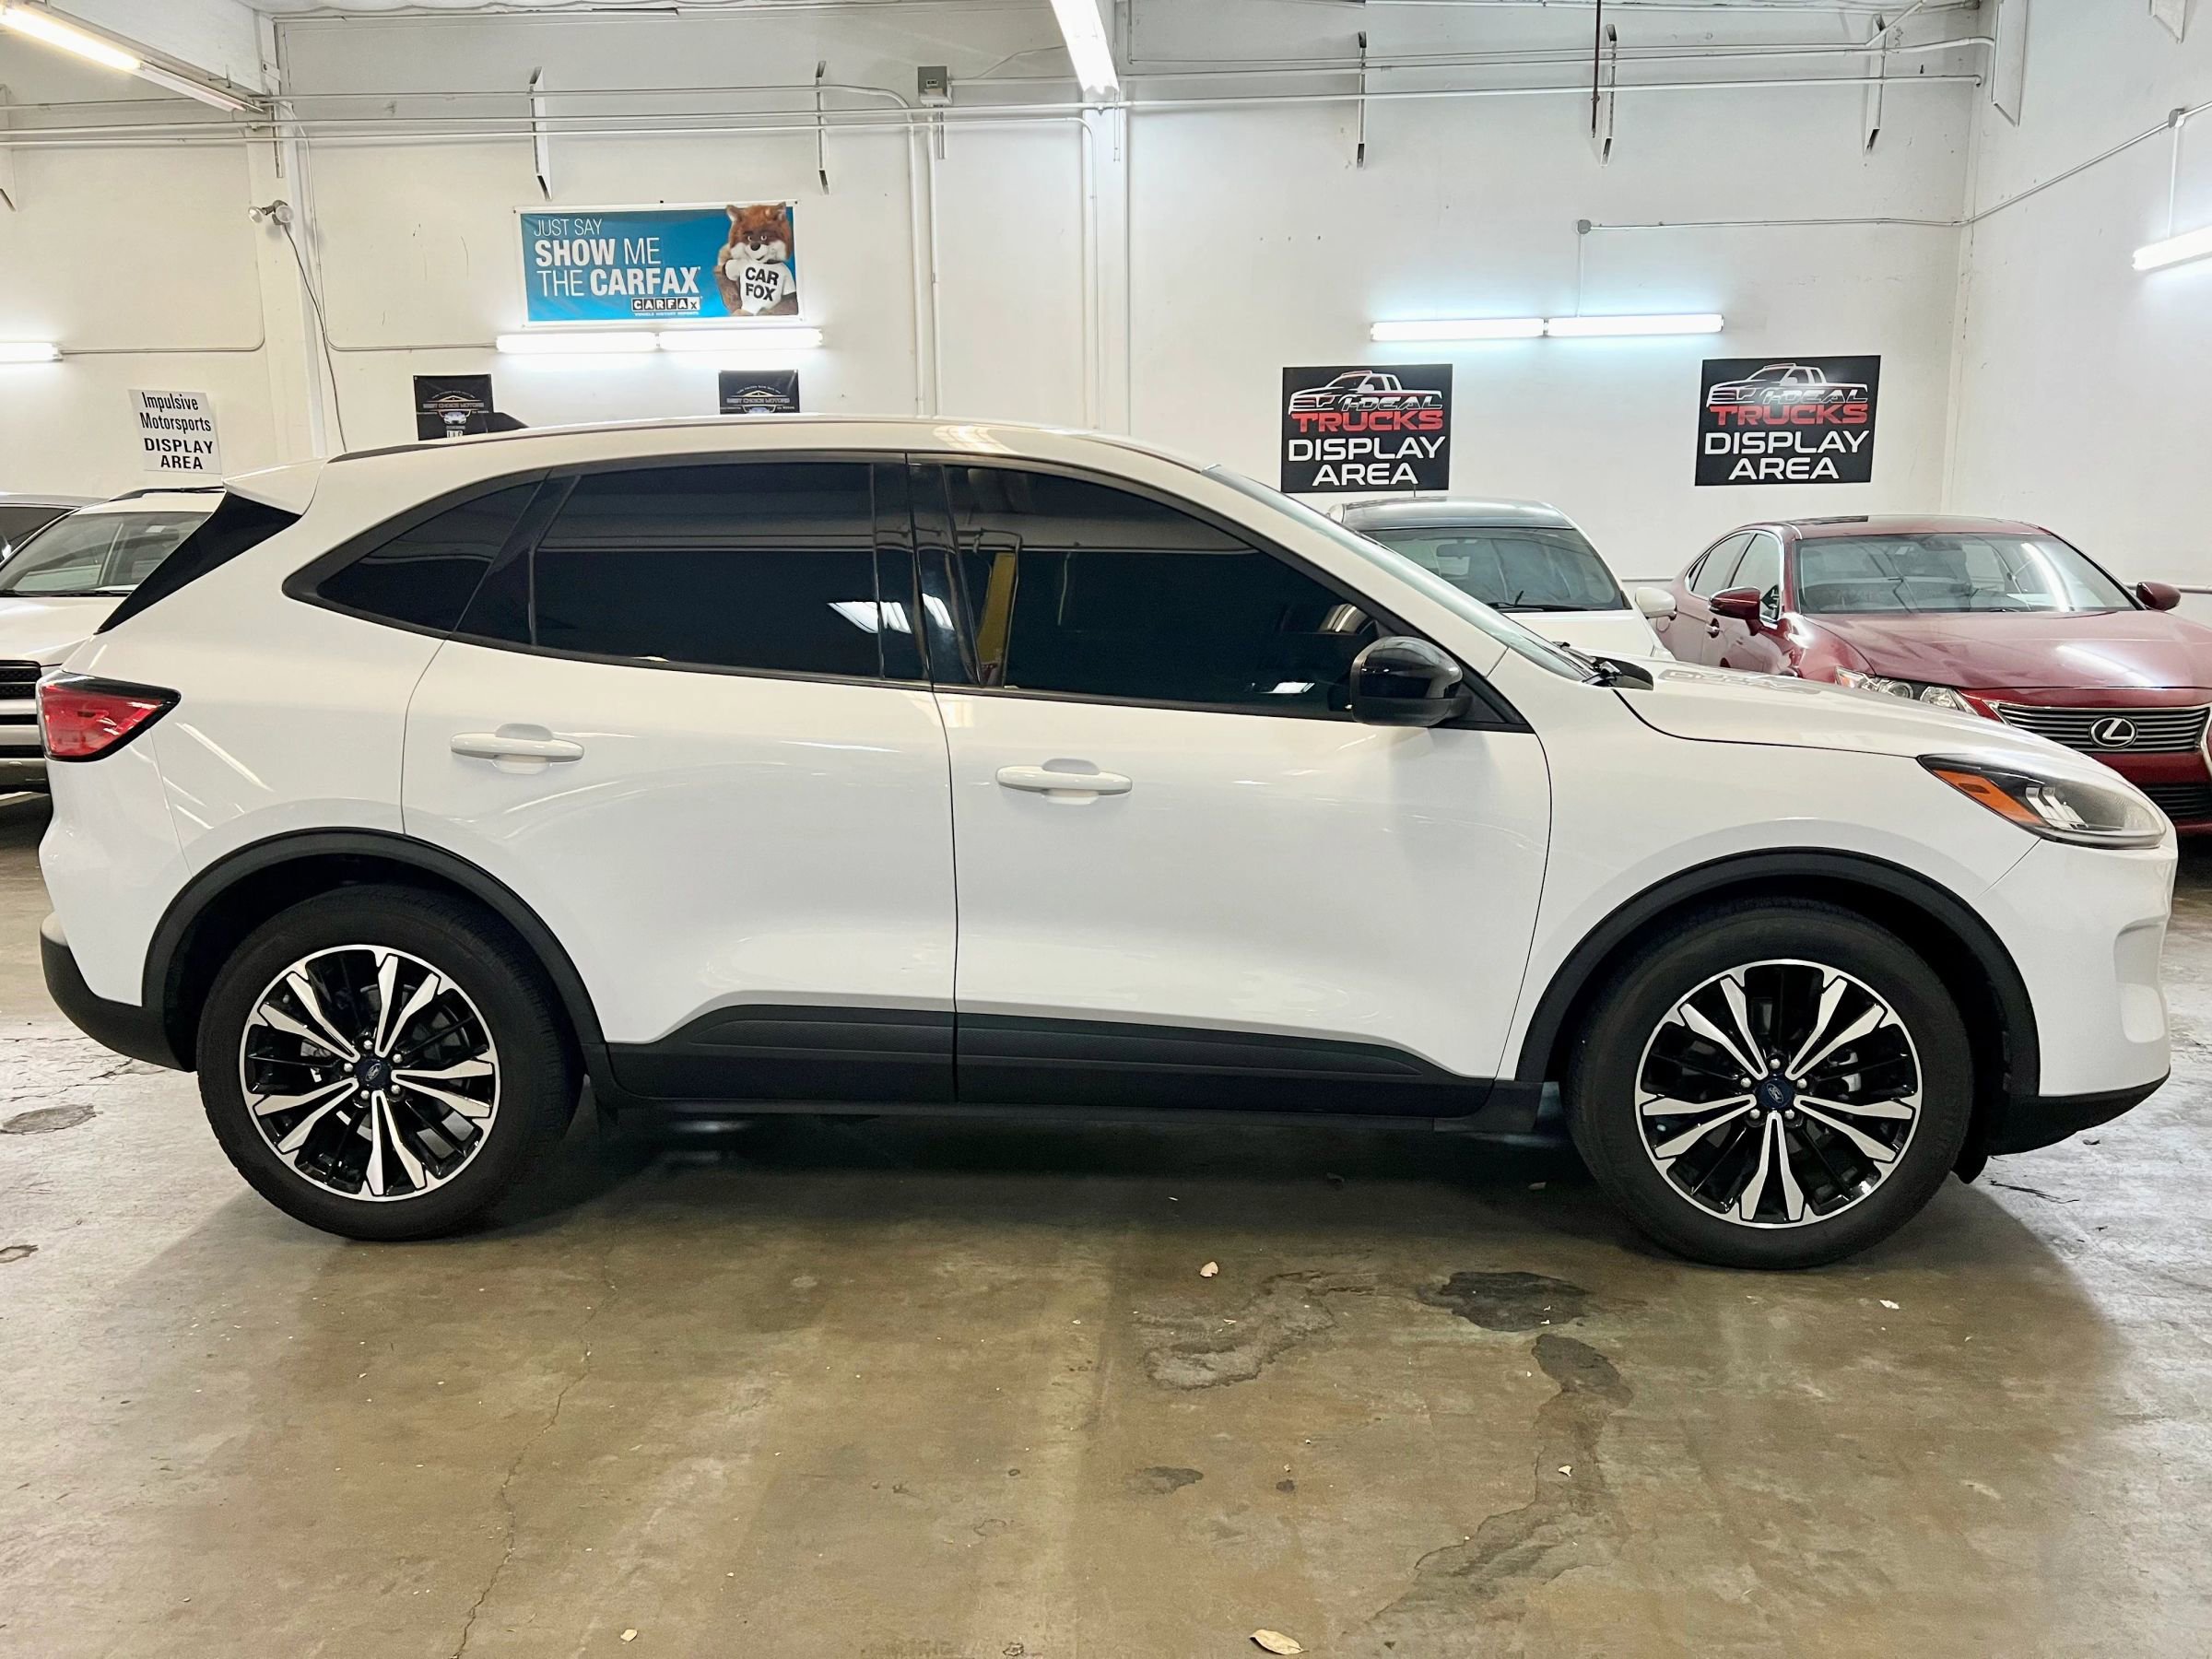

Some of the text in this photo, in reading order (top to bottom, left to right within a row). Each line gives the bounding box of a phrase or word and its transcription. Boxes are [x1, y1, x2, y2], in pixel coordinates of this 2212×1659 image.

[534, 218, 603, 236] JUST SAY
[535, 237, 662, 267] SHOW ME
[536, 266, 700, 297] THE CARFAX
[745, 266, 780, 287] CAR
[745, 282, 776, 301] FOX
[141, 391, 199, 413] Impulsive
[139, 412, 212, 434] Motorsports
[1292, 410, 1443, 433] TRUCKS
[1710, 404, 1869, 426] TRUCKS
[144, 438, 213, 454] DISPLAY
[1288, 436, 1446, 462] DISPLAY
[1705, 430, 1870, 455] DISPLAY
[160, 454, 204, 470] AREA
[1728, 456, 1840, 480] AREA
[1312, 463, 1419, 487] AREA
